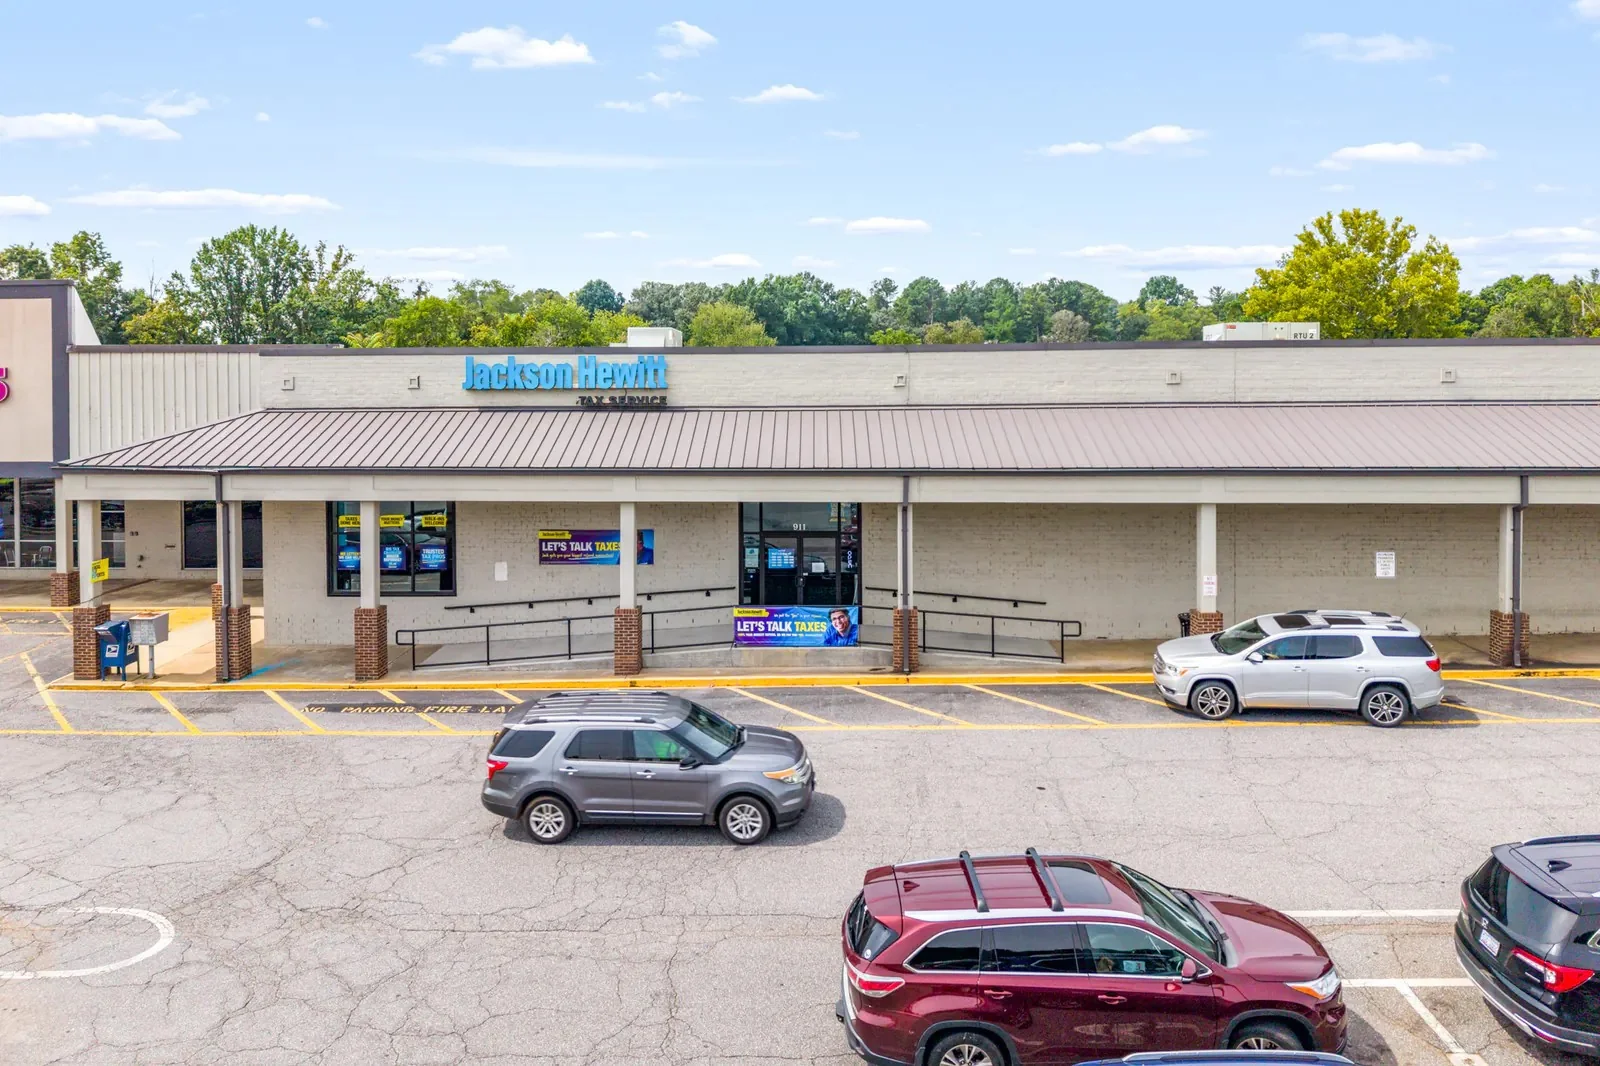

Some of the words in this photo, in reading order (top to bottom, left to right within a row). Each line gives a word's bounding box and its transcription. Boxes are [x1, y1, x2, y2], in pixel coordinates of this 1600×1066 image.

[462, 356, 573, 390] Jackson
[577, 355, 668, 389] Hewitt
[578, 395, 605, 406] TAX
[608, 395, 668, 406] SERVICE
[793, 523, 806, 531] 911
[542, 541, 567, 551] LET'S
[569, 541, 593, 551] TALK
[737, 621, 765, 632] LET'S
[766, 621, 792, 632] TALK
[794, 621, 827, 632] TAXES
[422, 705, 474, 713] FIRE
